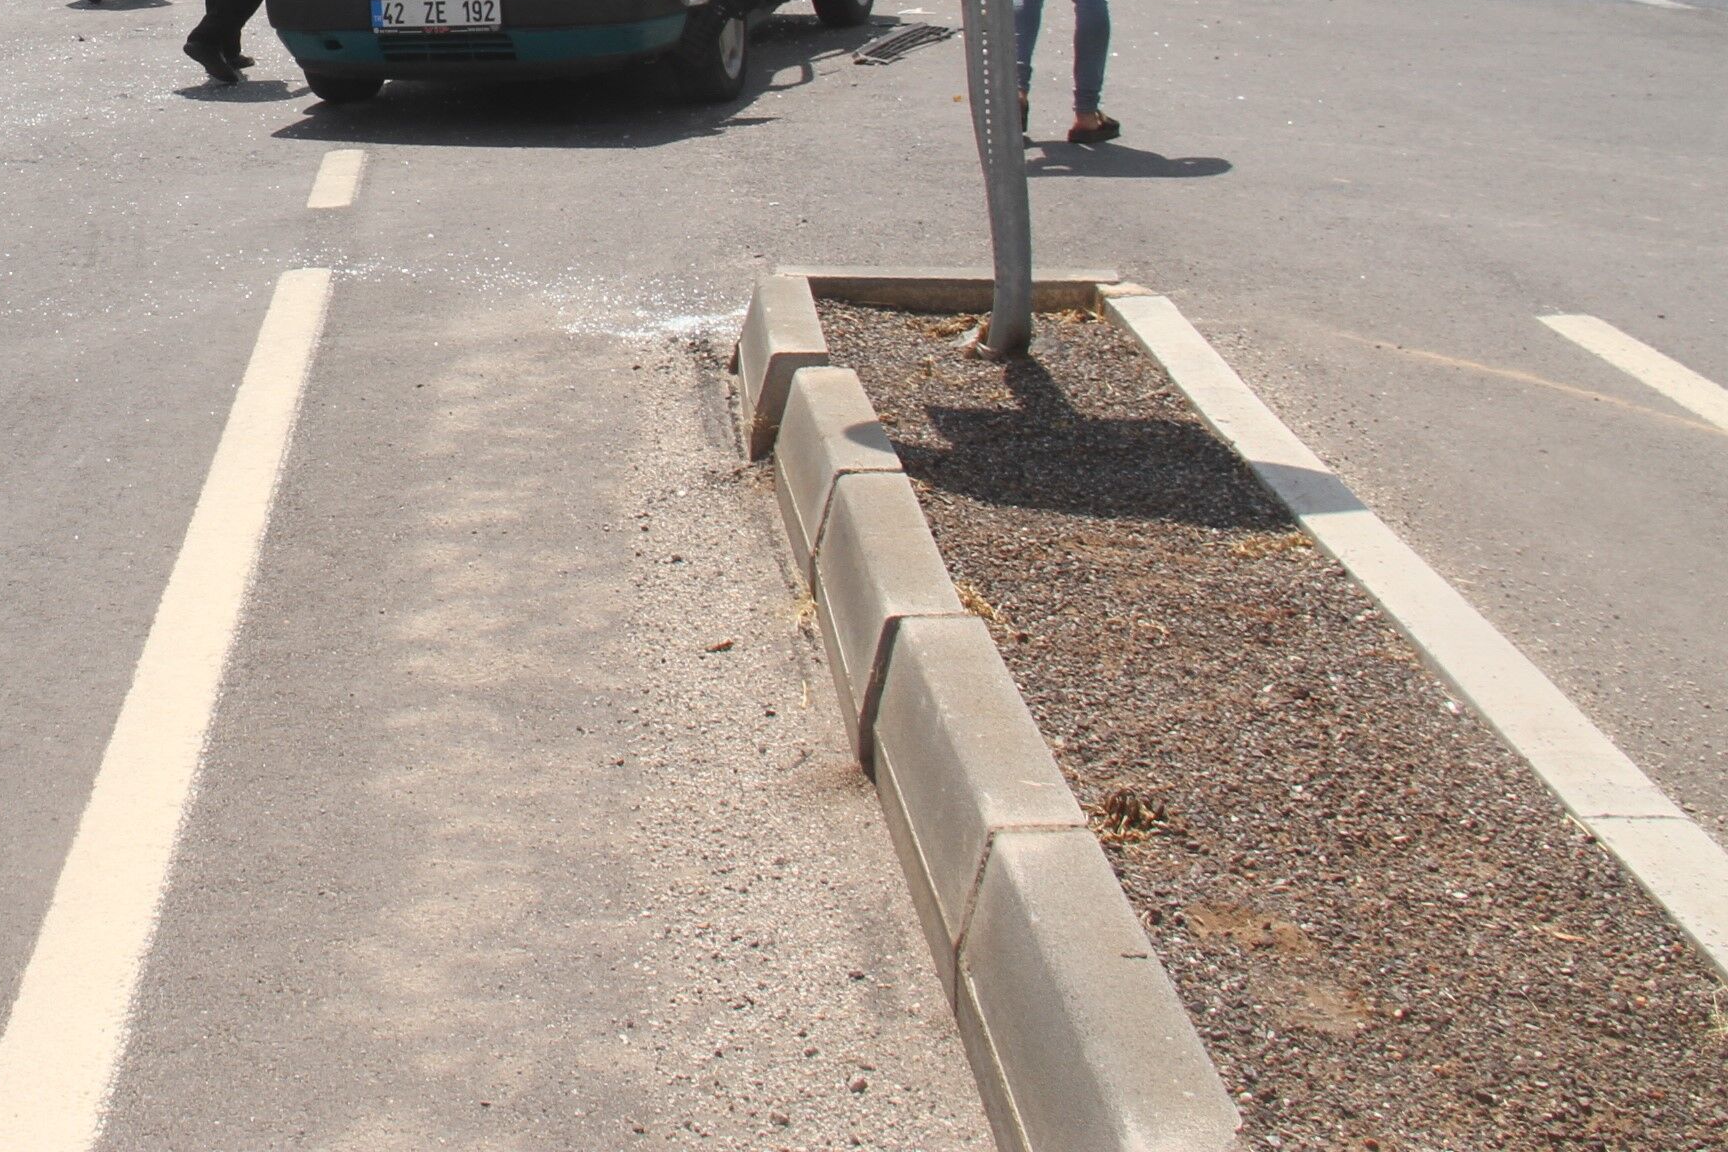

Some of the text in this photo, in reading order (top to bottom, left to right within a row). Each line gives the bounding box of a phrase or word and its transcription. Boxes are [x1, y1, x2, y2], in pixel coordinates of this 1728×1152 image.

[383, 0, 495, 24] 42 ZE 192
